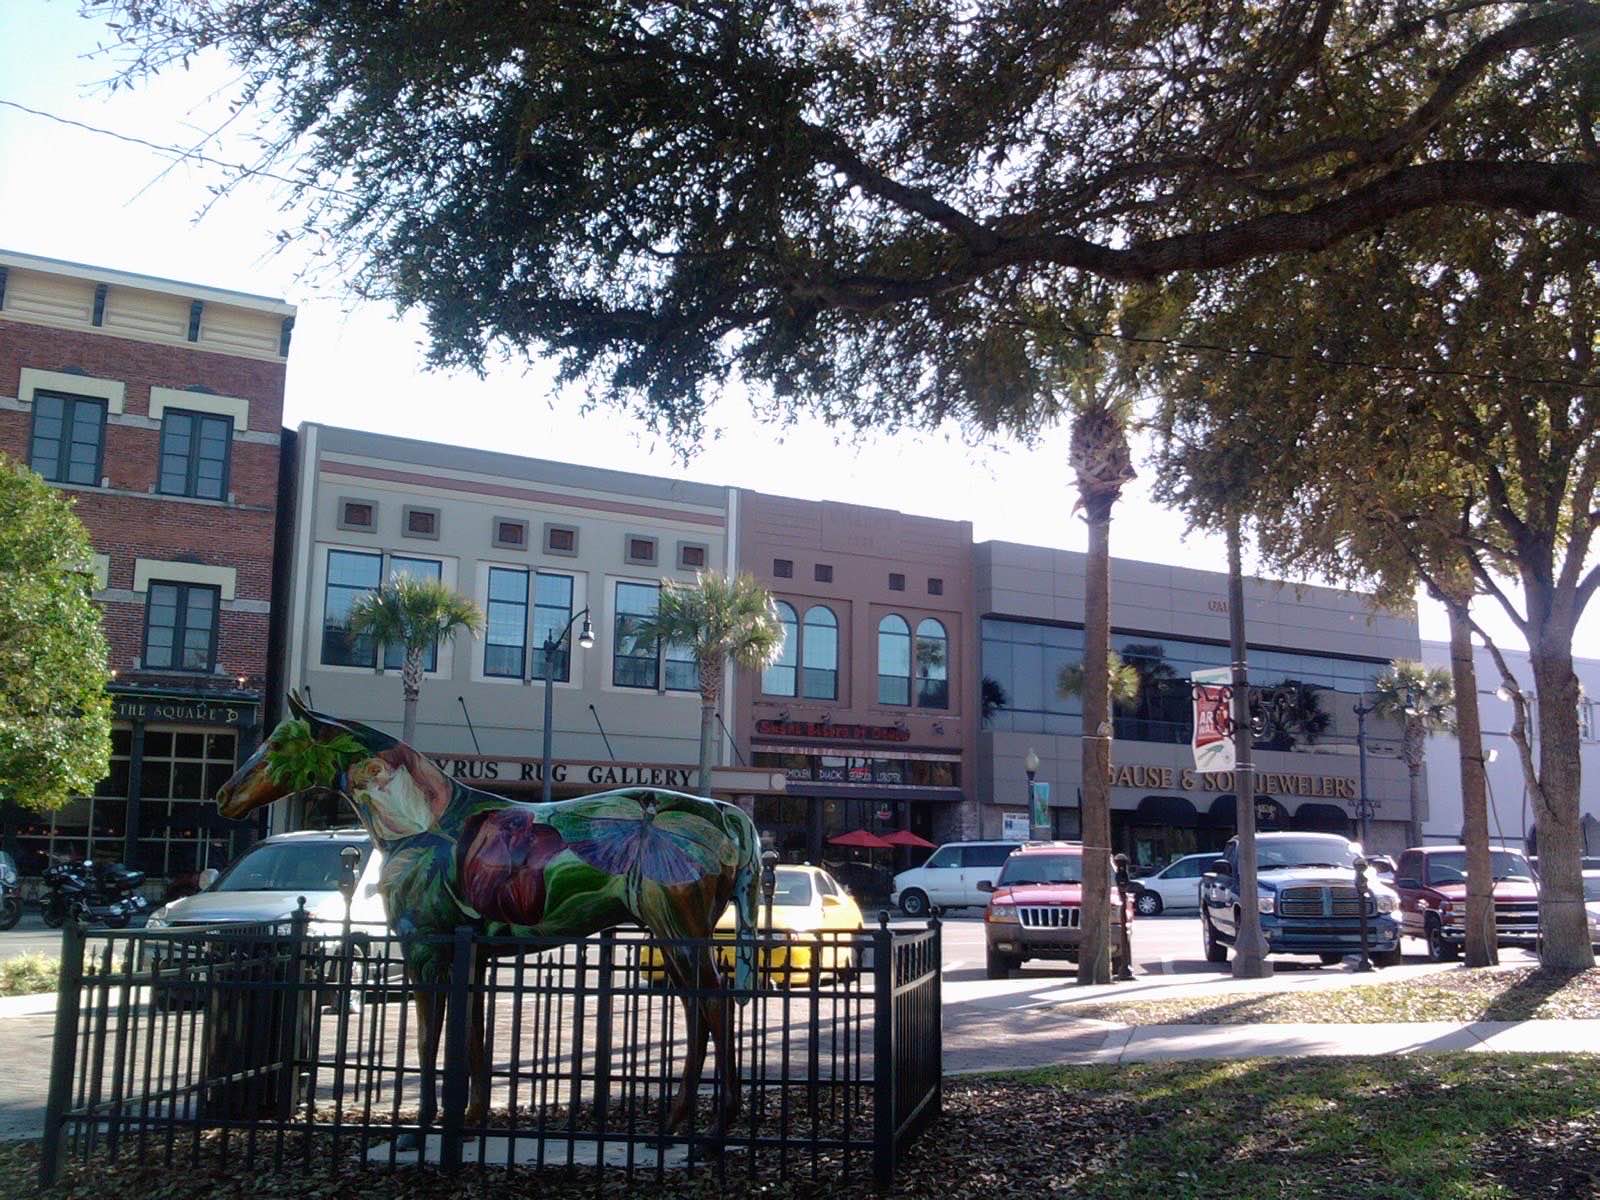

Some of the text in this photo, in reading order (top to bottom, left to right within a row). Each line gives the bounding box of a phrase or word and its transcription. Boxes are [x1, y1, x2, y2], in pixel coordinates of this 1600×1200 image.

[119, 703, 216, 720] THE SQUARE
[435, 758, 693, 787] YRUS RUG GALLERY
[819, 769, 843, 781] DUCK
[1182, 768, 1197, 791] &
[1255, 773, 1356, 799] JEWELERS
